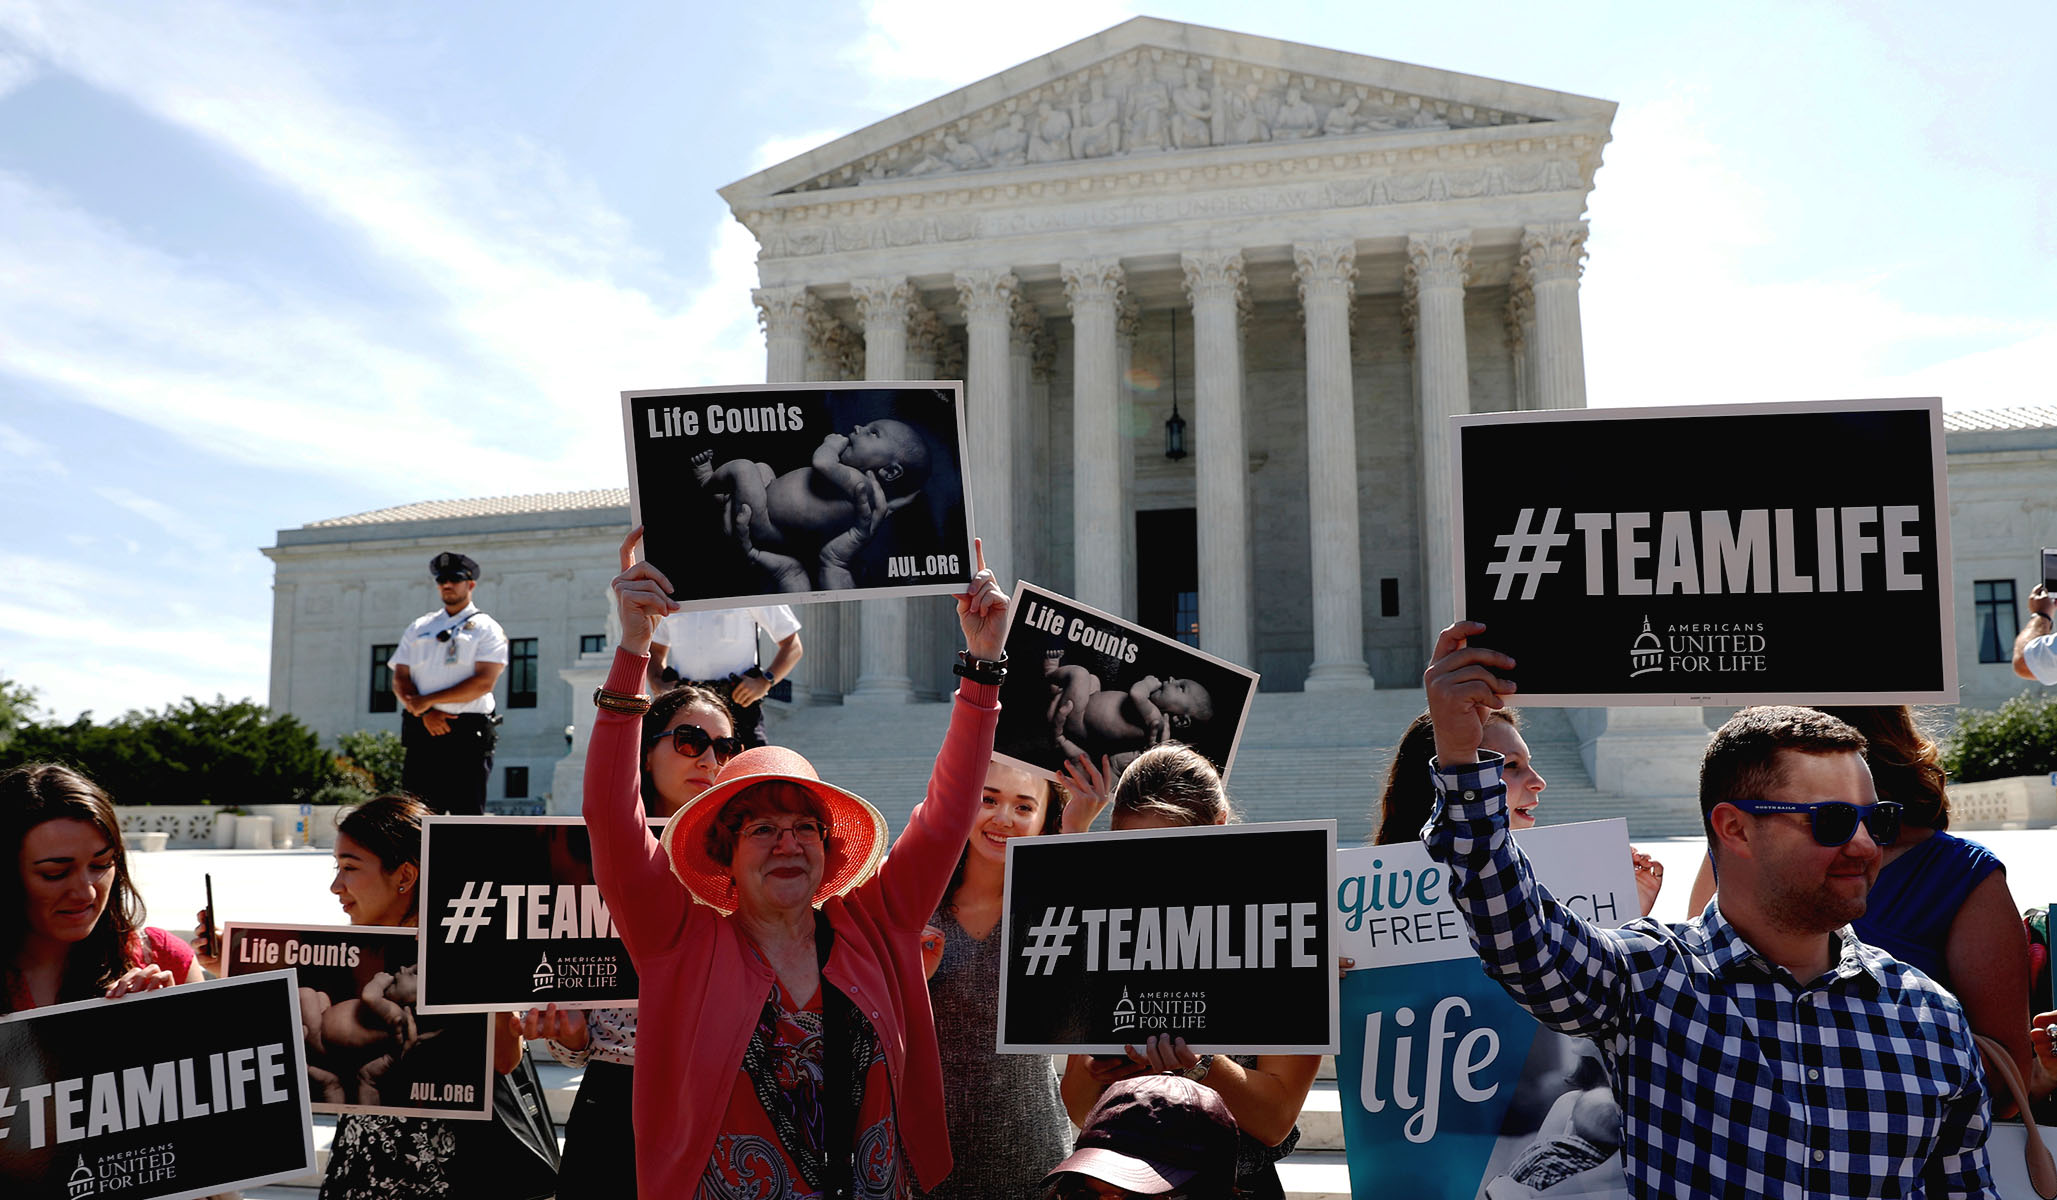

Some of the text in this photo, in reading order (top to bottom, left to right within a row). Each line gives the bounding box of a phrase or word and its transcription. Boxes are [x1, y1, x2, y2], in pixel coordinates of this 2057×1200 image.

[1079, 203, 1165, 226] JUSTICE
[1177, 195, 1251, 216] UNDER
[1262, 190, 1306, 211] LAW
[648, 402, 804, 438] Life Counts
[888, 555, 960, 577] AUL.ORG
[1486, 506, 1922, 600] #TEAMLIFE
[1025, 602, 1139, 663] Life Counts
[1669, 623, 1764, 633] AMERICANS
[1669, 635, 1766, 653] UNITED
[1669, 655, 1767, 672] FOR LIFE
[1338, 859, 1440, 932] give
[1022, 902, 1317, 975] #TEAMLIFE
[1369, 910, 1459, 947] FREE
[240, 937, 360, 968] Life Counts
[557, 963, 617, 976] UNITED
[557, 975, 617, 988] FOR LIFE
[1139, 991, 1206, 999] AMERICANS
[1140, 1000, 1206, 1015] UNITED
[1139, 1015, 1206, 1029] FOR LIFE
[1360, 996, 1500, 1144] life
[0, 1043, 288, 1150] TEAMLIFE
[410, 1082, 474, 1103] AUL.ORG
[98, 1142, 174, 1163] AMERICANS
[99, 1152, 175, 1178] UNITED
[100, 1166, 177, 1193] FOR LIFE
